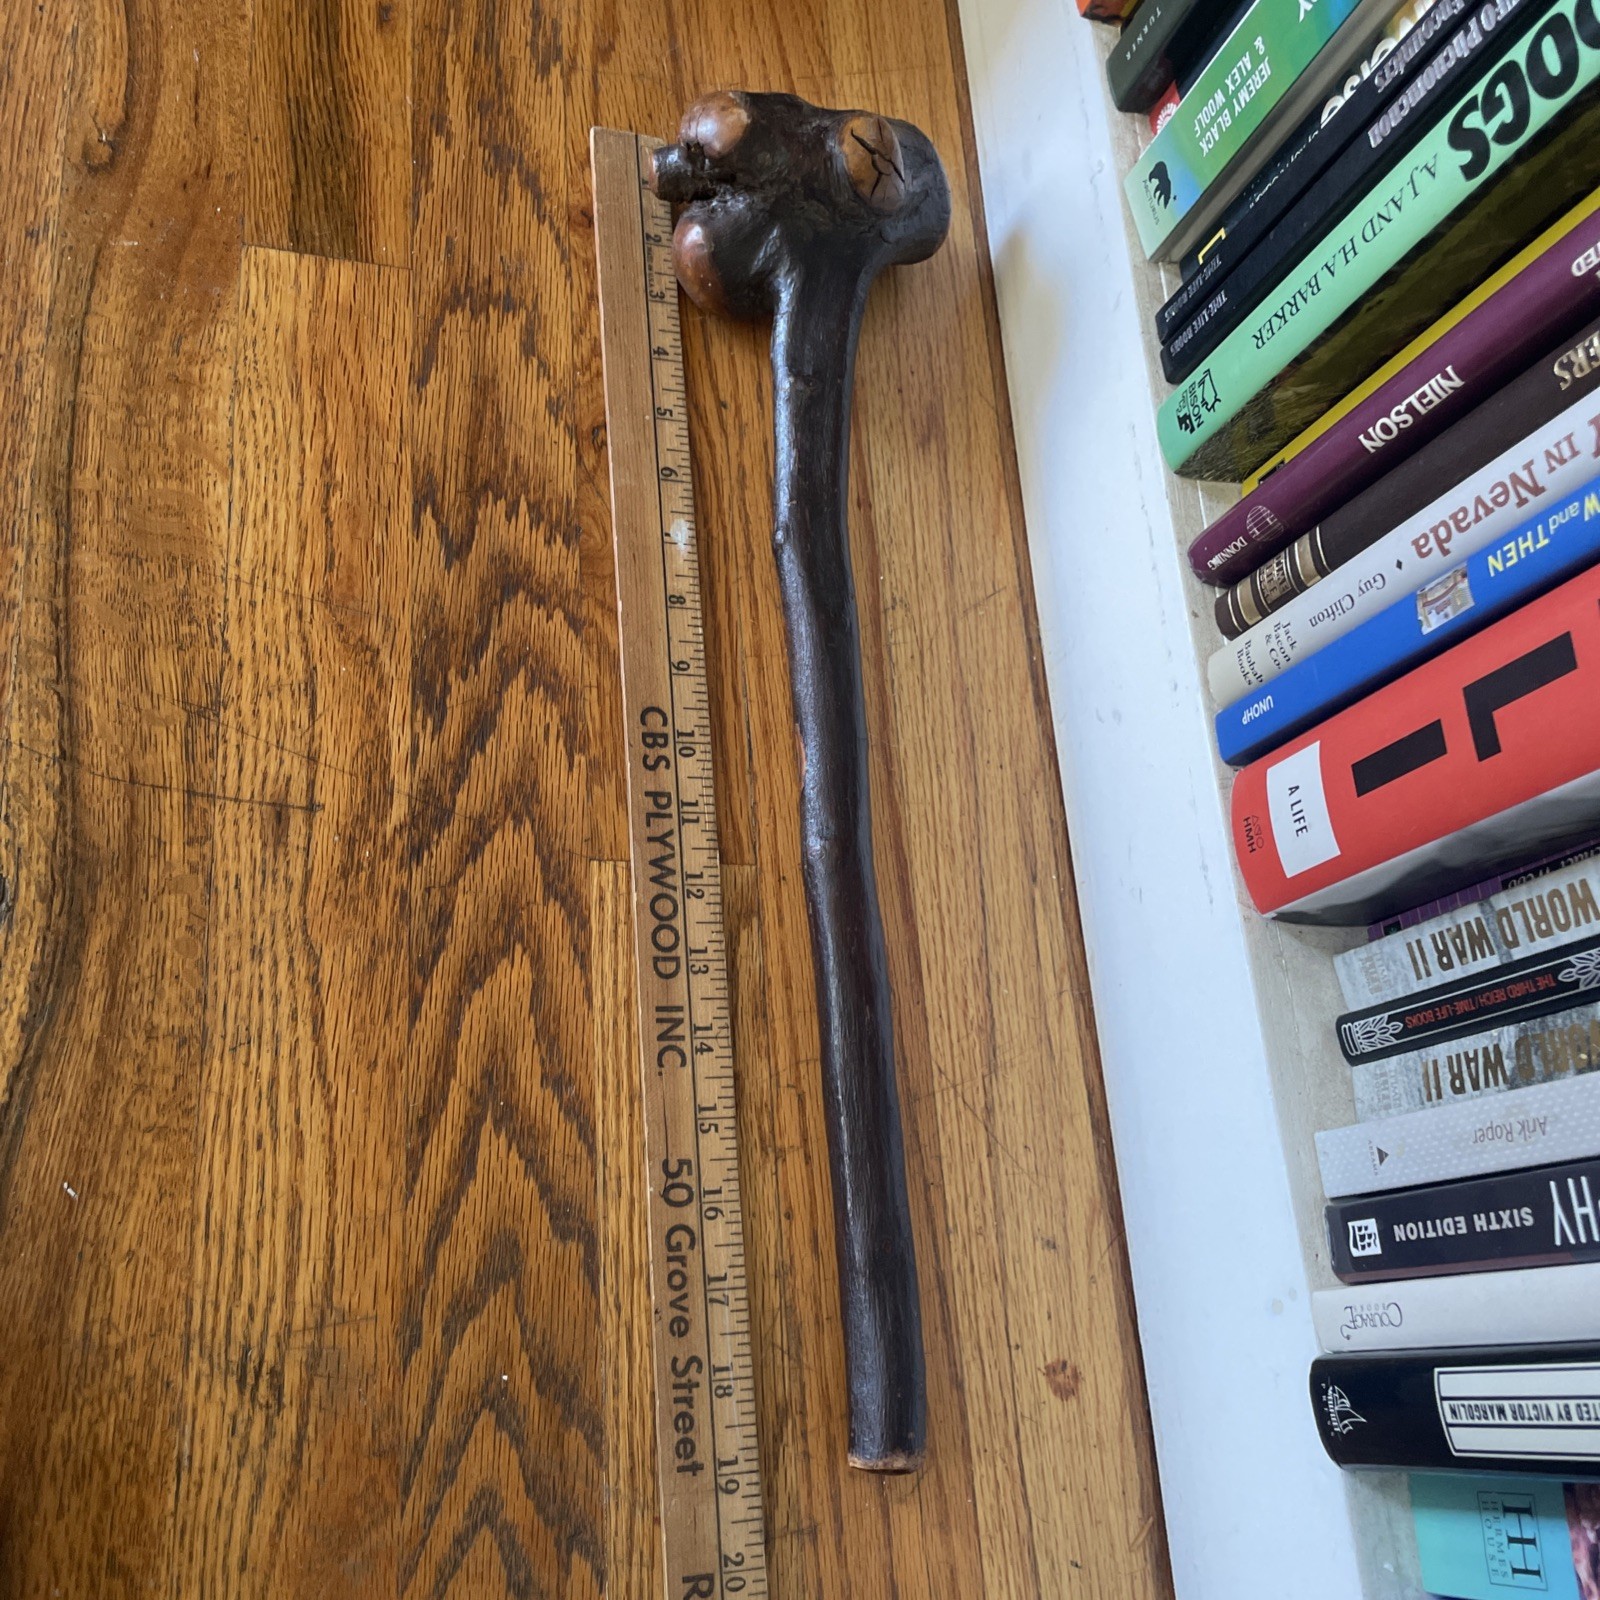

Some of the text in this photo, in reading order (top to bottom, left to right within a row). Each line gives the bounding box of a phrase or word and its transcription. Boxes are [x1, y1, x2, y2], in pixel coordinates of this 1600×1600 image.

[1126, 6, 1161, 60] TURNER
[1193, 36, 1265, 138] & ALEX WOOLF
[1199, 56, 1271, 157] JEREMY BLACK
[1361, 188, 1404, 243] AND
[645, 232, 661, 243] 2
[650, 290, 665, 300] 3
[1252, 272, 1322, 350] BARKER
[653, 346, 669, 356] 4
[656, 407, 673, 418] 5
[1188, 381, 1204, 428] BISON
[1358, 365, 1465, 454] NIELSON
[660, 467, 678, 479] 6
[1411, 459, 1547, 559] Nevada
[1548, 501, 1580, 535] and
[1206, 535, 1248, 571] DONNING
[1486, 524, 1549, 578] THEN
[668, 594, 686, 605] 8
[1309, 571, 1386, 628] Guy Clifton
[1264, 634, 1273, 646] &
[1273, 620, 1291, 663] Bacon
[1281, 621, 1298, 651] Jack
[671, 660, 690, 672] 9
[1236, 648, 1253, 686] Books
[1244, 639, 1264, 684] Baobab
[1241, 695, 1274, 725] UNOHP
[676, 729, 696, 758] 10
[680, 799, 700, 826] 11
[1288, 784, 1309, 838] A LIFE
[1242, 816, 1257, 854] HMH
[639, 705, 687, 1077] CBS PLYWOOD INC.
[685, 871, 705, 899] 12
[1496, 877, 1600, 950] WORLD
[688, 946, 709, 976] 13
[1405, 938, 1433, 982] II
[1431, 916, 1496, 972] WAR
[1507, 980, 1537, 999] THIRD
[1536, 972, 1557, 991] THE
[1405, 1012, 1435, 1029] BOOKS
[693, 1022, 714, 1056] 14
[1421, 1058, 1444, 1103] II
[1446, 1043, 1510, 1095] WAR
[697, 1103, 719, 1134] 15
[1473, 1116, 1548, 1145] Arik Roper
[702, 1185, 725, 1221] 16
[1394, 1206, 1534, 1242] SIXTH EDITION
[707, 1272, 730, 1307] 17
[661, 1158, 705, 1477] 50 Grove Street
[1340, 1302, 1403, 1340] COURAGE
[712, 1362, 734, 1399] 18
[1448, 1403, 1507, 1421] MARGOLIN
[1508, 1403, 1554, 1421] VICTOR
[1556, 1403, 1573, 1421] BY
[717, 1455, 740, 1495] 19
[1481, 1501, 1499, 1577] HOUSE
[1491, 1500, 1509, 1578] HERMES
[723, 1552, 746, 1593] 20
